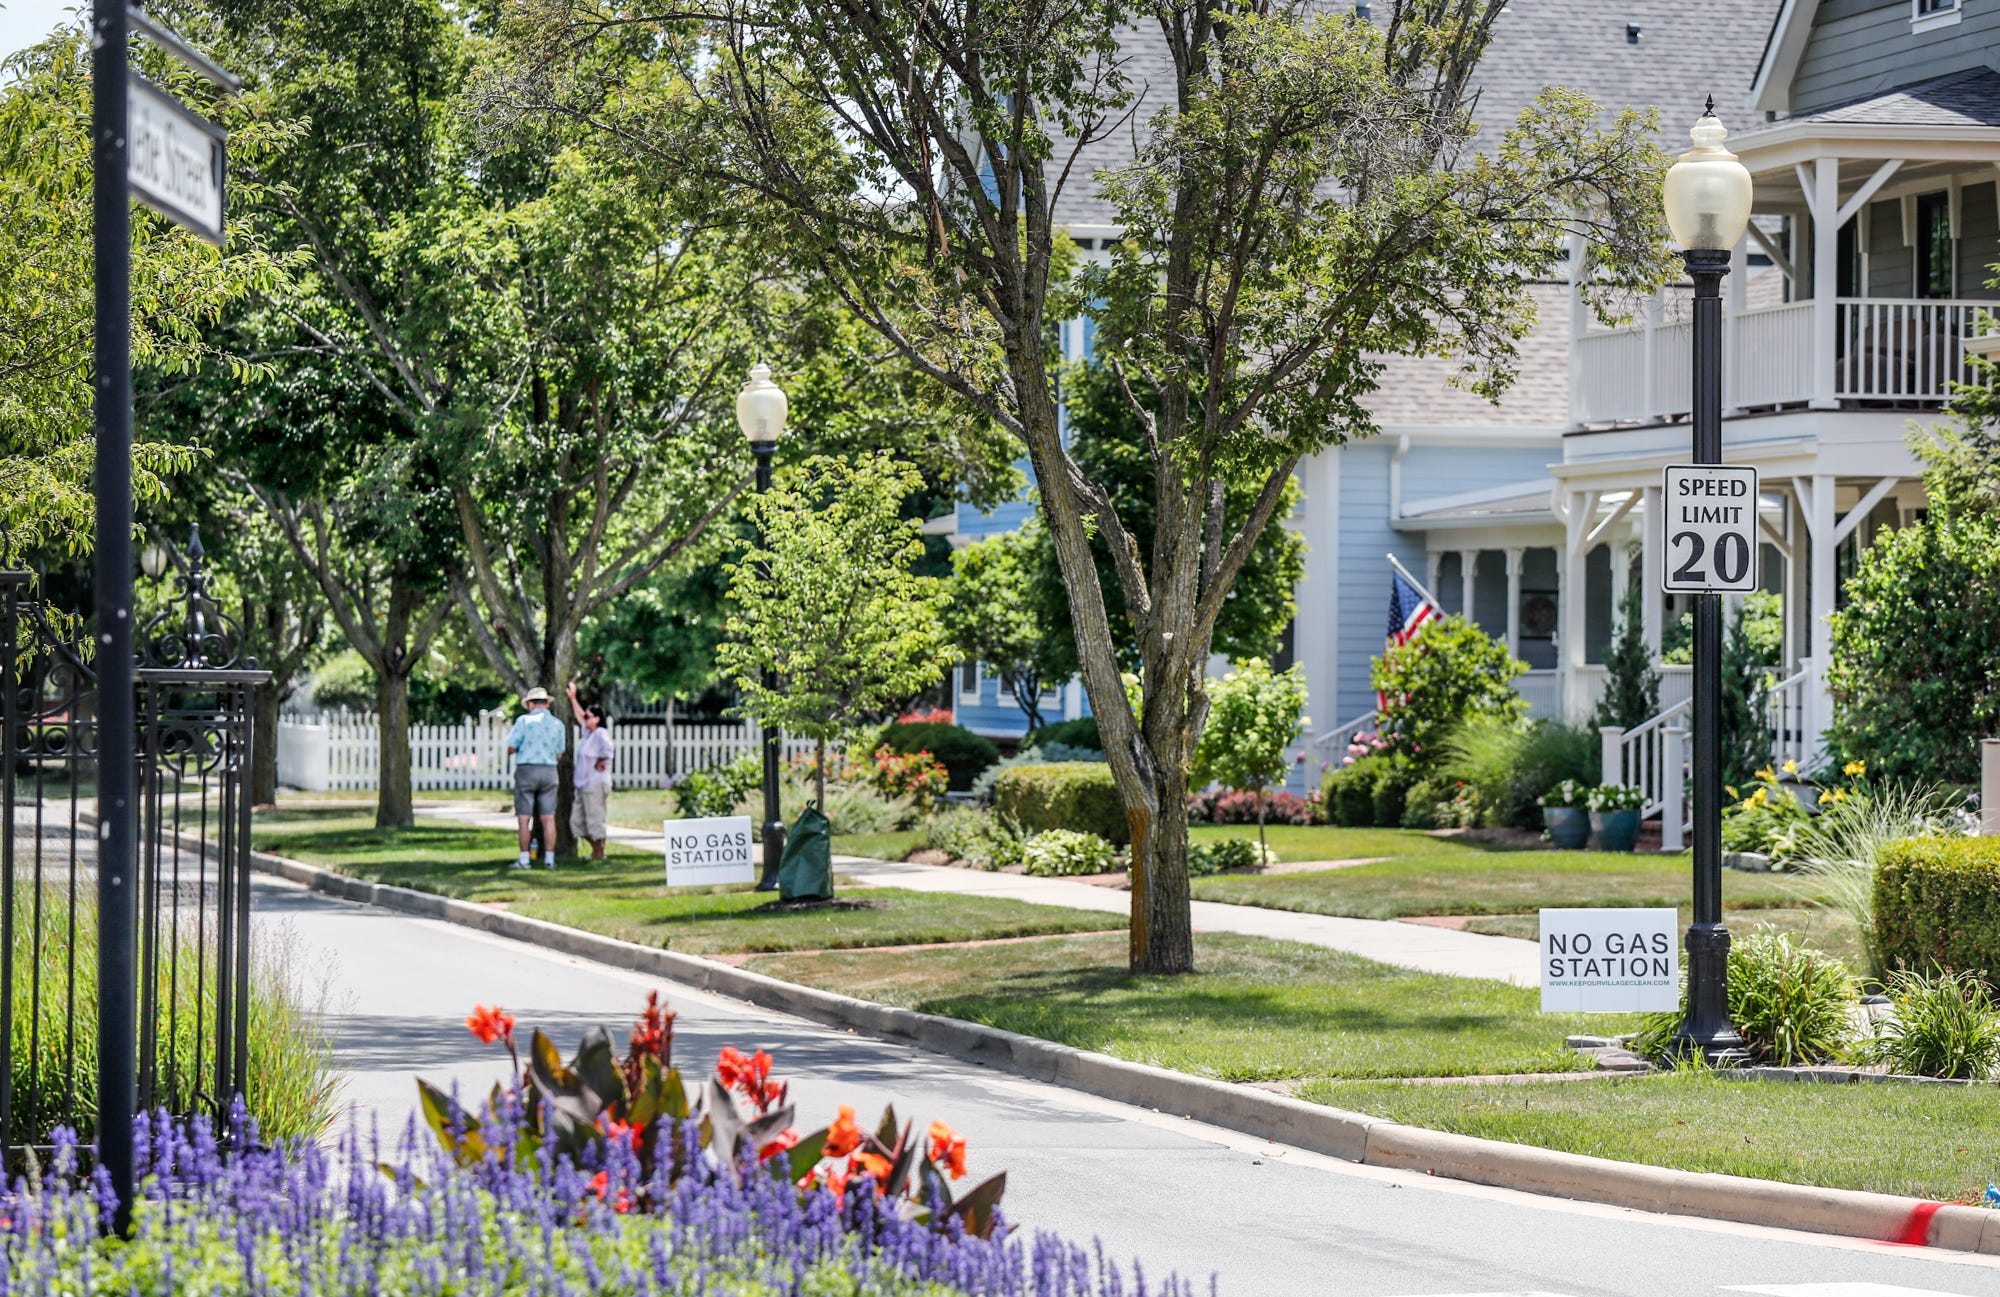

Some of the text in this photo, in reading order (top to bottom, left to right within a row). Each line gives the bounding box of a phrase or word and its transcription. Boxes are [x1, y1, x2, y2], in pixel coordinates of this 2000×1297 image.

[1678, 478, 1748, 497] SPEED
[1682, 505, 1743, 524] LIMIT
[1671, 531, 1750, 584] 20
[670, 832, 747, 850] NO GAS
[671, 848, 748, 865] STATION
[1549, 933, 1669, 955] NO GAS
[1549, 957, 1669, 978] STATION
